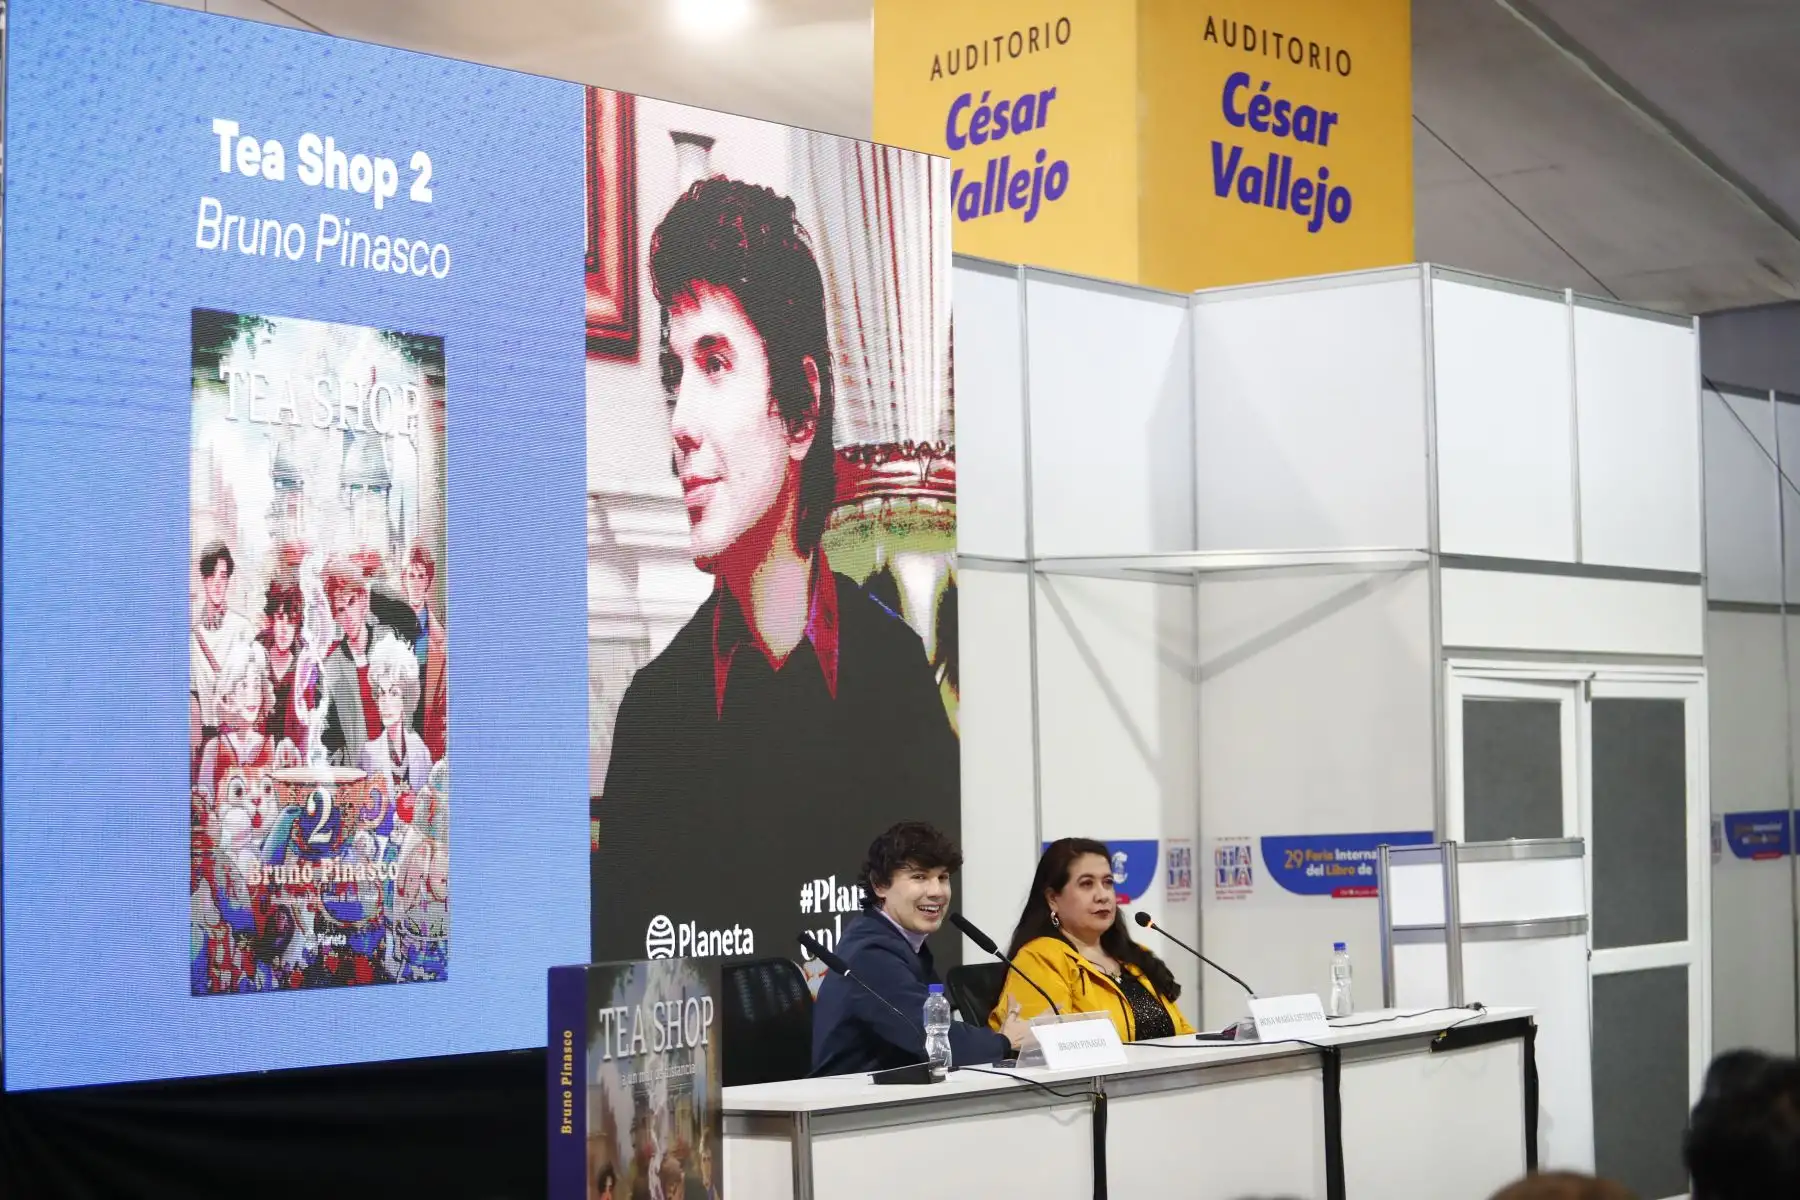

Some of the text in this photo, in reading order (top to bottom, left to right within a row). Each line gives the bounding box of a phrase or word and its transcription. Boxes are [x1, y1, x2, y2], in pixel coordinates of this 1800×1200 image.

[930, 16, 1071, 81] AUDITORIO
[1204, 15, 1352, 77] AUDITORIO
[945, 86, 1057, 151] César
[1222, 71, 1338, 147] César
[212, 118, 433, 210] Tea Shop 2
[1211, 140, 1352, 233] Vallejo
[195, 195, 451, 279] Bruno Pinasco
[219, 360, 421, 437] TEA SHOP
[306, 787, 333, 844] 2
[250, 858, 399, 884] Bruno Pinasco
[1284, 849, 1304, 869] 29
[1306, 862, 1374, 877] del Libro de
[678, 920, 754, 957] Planeta
[599, 995, 714, 1062] TEA SHOP
[560, 1030, 573, 1135] Bruno Pinasco
